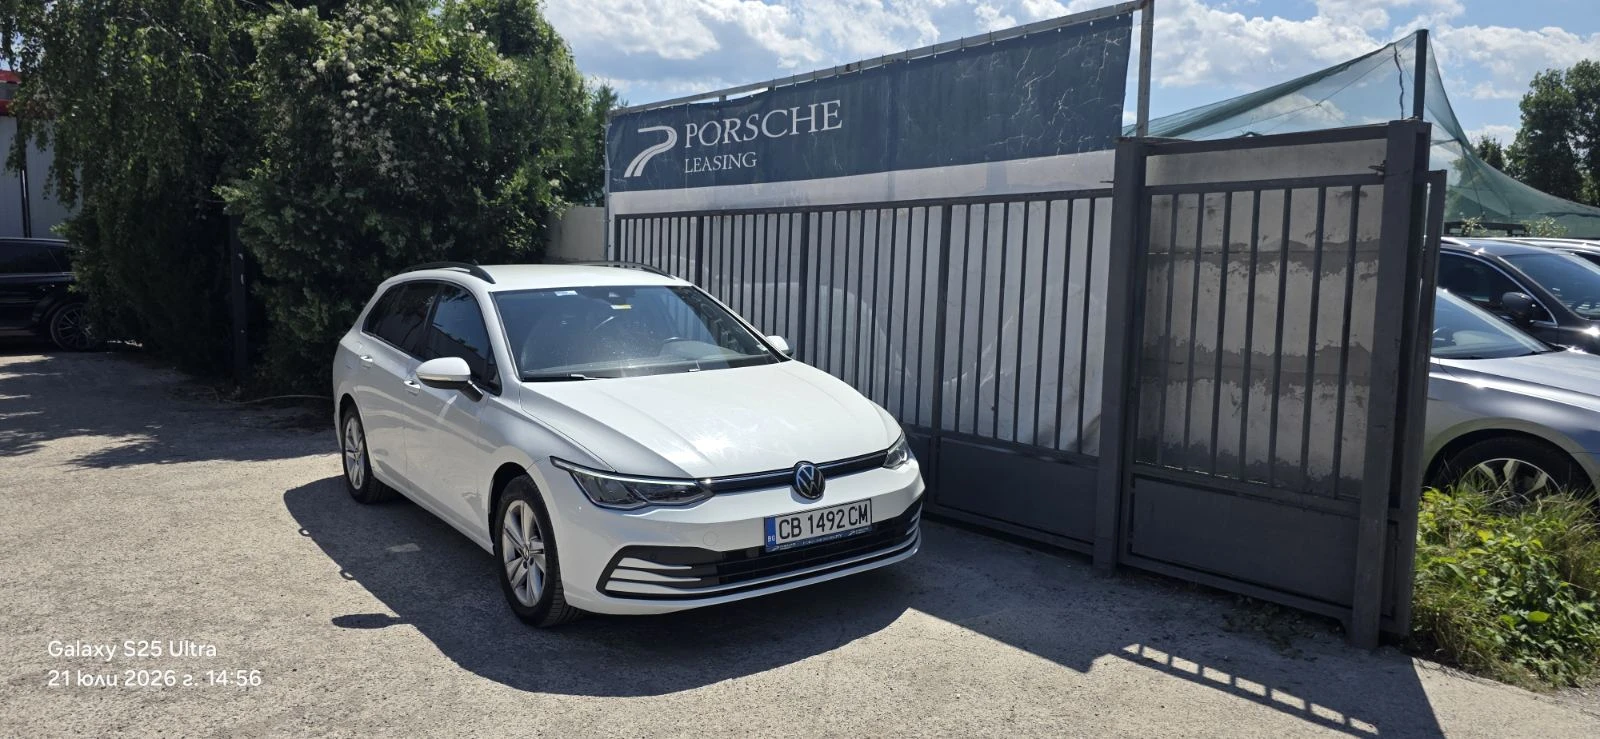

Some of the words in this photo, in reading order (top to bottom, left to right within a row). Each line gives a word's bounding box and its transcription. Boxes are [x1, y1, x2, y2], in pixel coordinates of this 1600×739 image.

[684, 99, 843, 148] PORSCHE
[684, 152, 757, 174] LEASING
[778, 517, 802, 540] CB
[807, 508, 846, 535] 1492
[848, 503, 868, 526] CM
[767, 535, 776, 543] BG
